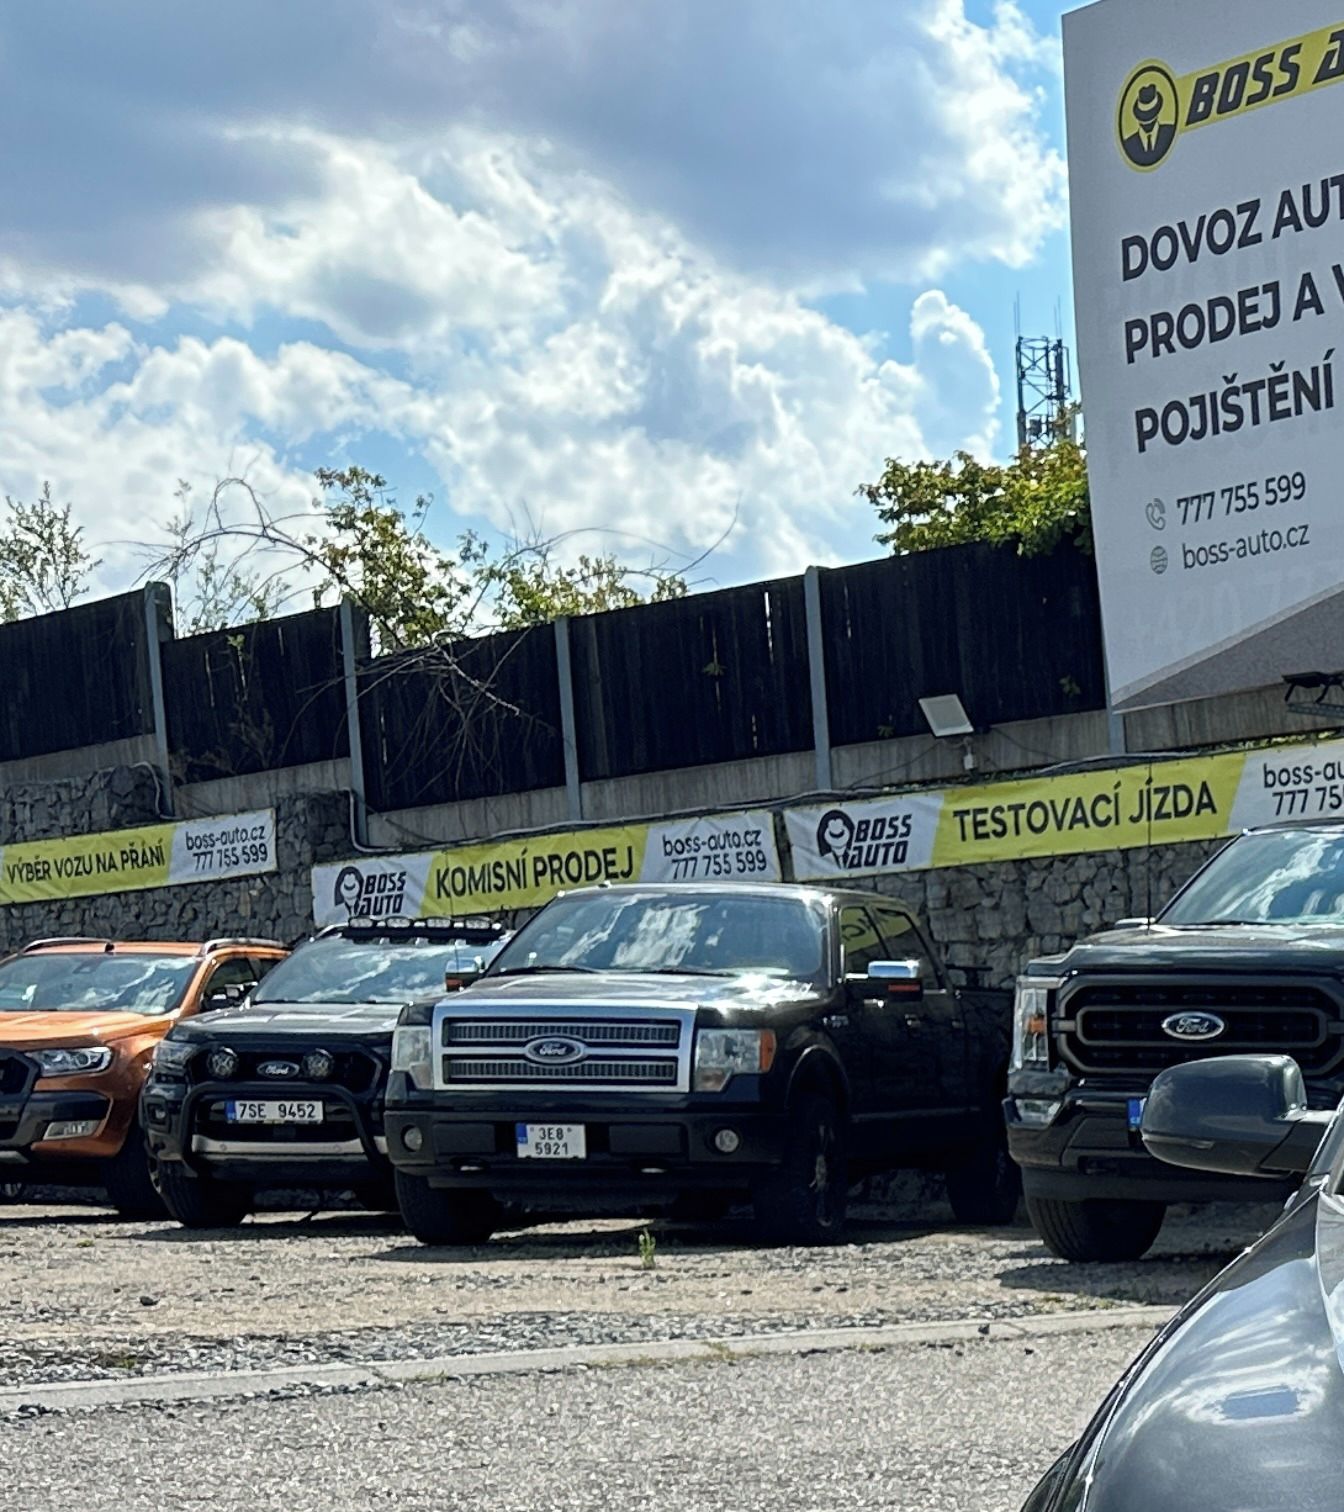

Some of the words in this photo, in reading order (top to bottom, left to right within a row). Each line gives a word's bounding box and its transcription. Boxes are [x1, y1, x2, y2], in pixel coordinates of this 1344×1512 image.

[1185, 43, 1302, 126] BOSS
[1121, 199, 1262, 281] DOVOZ
[1124, 281, 1281, 364] PRODEJ
[1292, 272, 1325, 321] A
[1135, 348, 1335, 453] POJIŠTĚNÍ
[1176, 491, 1216, 525] 777
[1221, 482, 1260, 516] 755
[1264, 471, 1306, 506] 599
[1182, 524, 1310, 569] boss-auto.cz
[953, 781, 1122, 842] TESTOVACÍ
[1129, 778, 1217, 823] JÍZDA
[1272, 788, 1309, 816] 777
[185, 825, 266, 850] boss-auto.cz
[854, 814, 912, 842] BOSS
[54, 854, 93, 877] VOZU
[97, 852, 117, 874] NA
[120, 838, 166, 870] PŘÁNÍ
[192, 852, 215, 871] 777
[217, 847, 240, 868] 755
[242, 843, 268, 864] 599
[662, 830, 762, 857] boss-auto.cz
[848, 841, 909, 868] AUTO
[436, 849, 528, 899] KOMISNÍ
[534, 846, 634, 887] PRODEJ
[672, 857, 698, 880] 777
[703, 853, 732, 877] 755
[736, 849, 767, 873] 599
[364, 871, 406, 894] BOSS
[358, 894, 404, 916] AUTO
[239, 1103, 267, 1119] 7SE
[278, 1103, 315, 1119] 9452
[538, 1127, 564, 1140] 3E8
[535, 1142, 568, 1155] 5921
